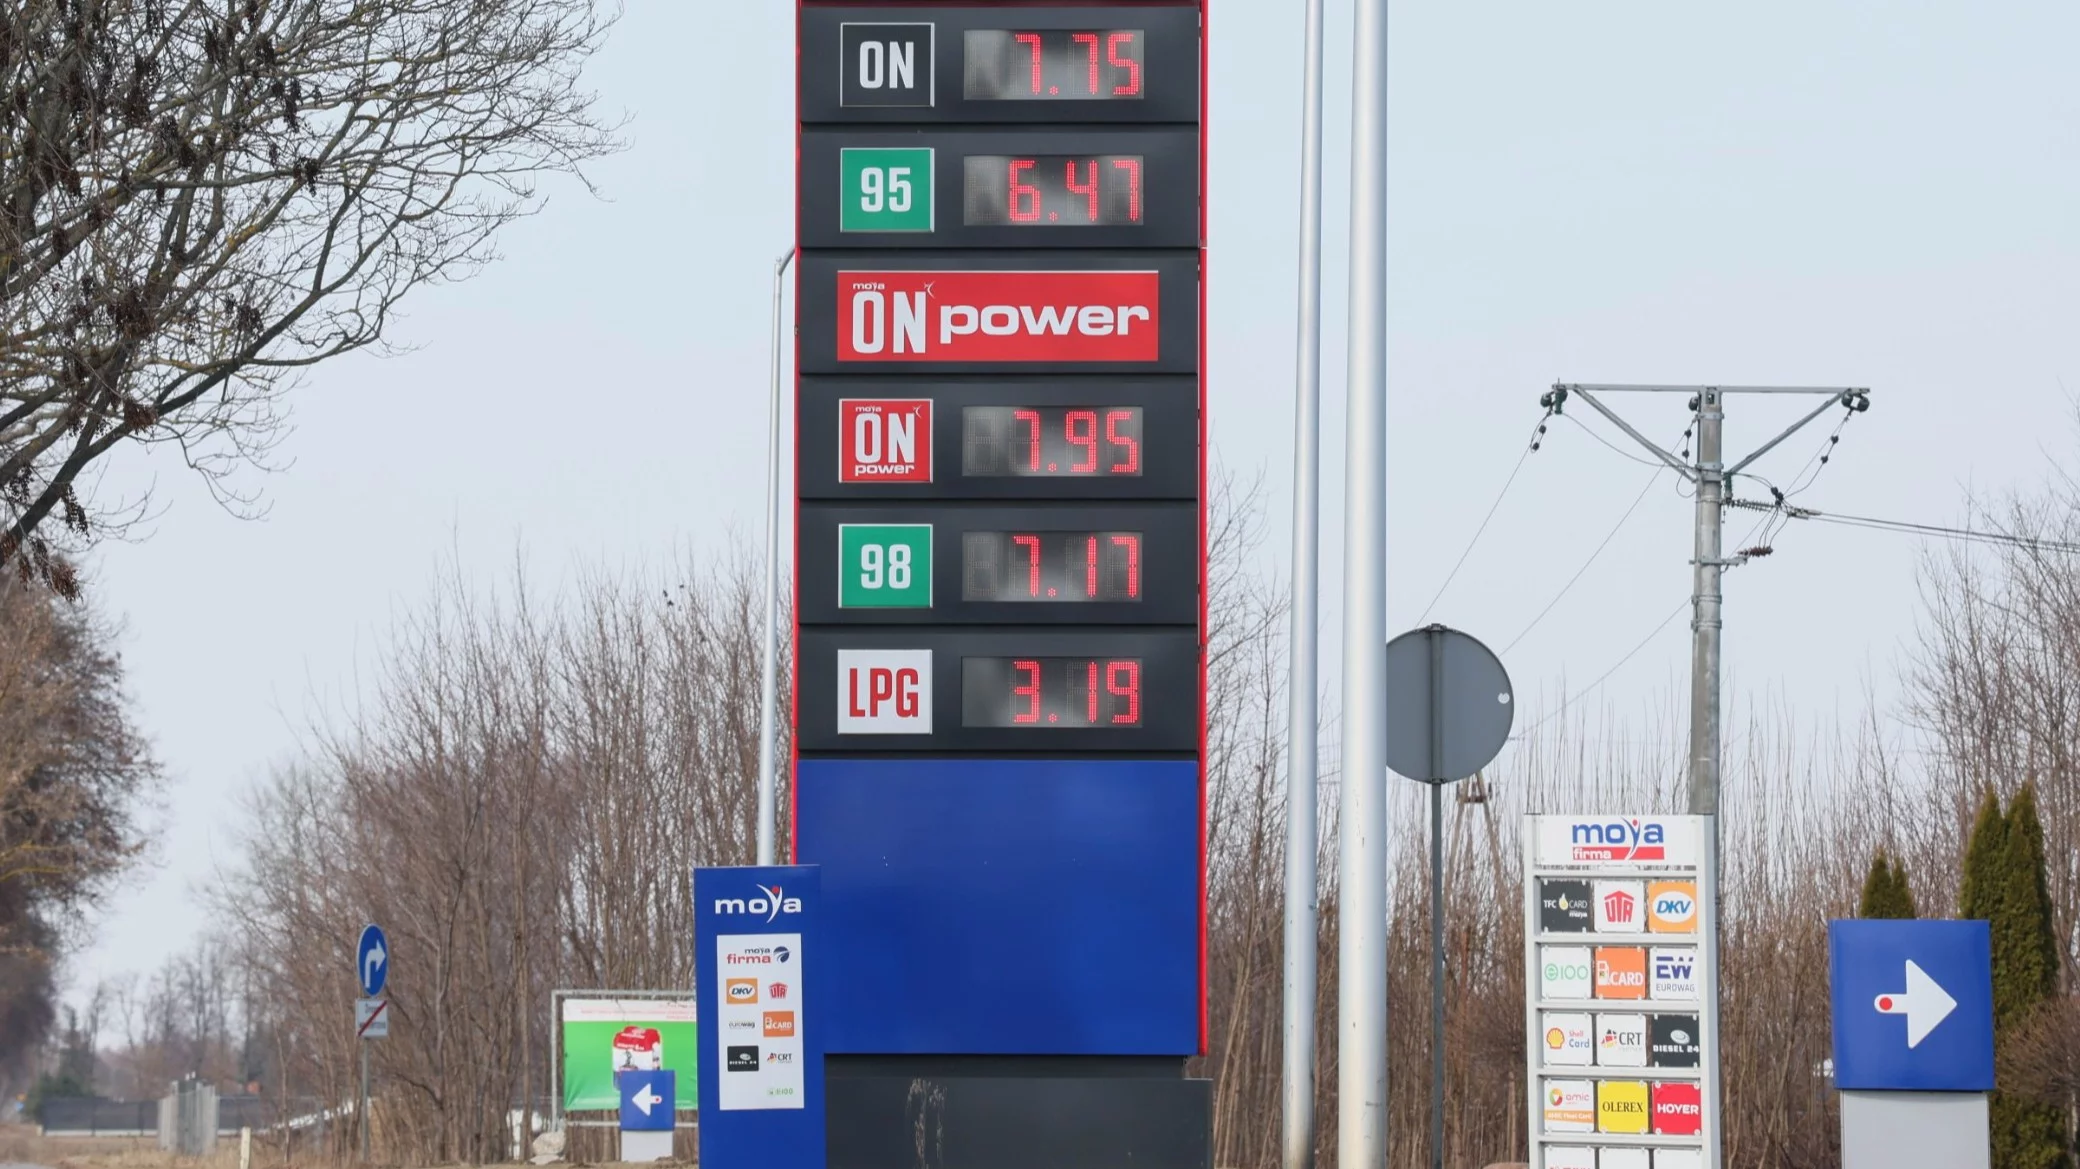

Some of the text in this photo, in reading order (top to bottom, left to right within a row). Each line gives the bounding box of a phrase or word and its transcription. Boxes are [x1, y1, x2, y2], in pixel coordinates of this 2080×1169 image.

[859, 41, 914, 89] ON
[1014, 33, 1140, 95] 7.75
[860, 167, 912, 212] 95
[1008, 160, 1139, 222] 6.47
[852, 291, 1149, 354] ON power
[855, 412, 915, 463] ON
[1014, 410, 1138, 473] 7.95
[855, 464, 915, 477] power
[860, 544, 912, 589] 98
[1013, 536, 1137, 598] 7.17
[849, 668, 919, 718] LPG
[1013, 661, 1138, 724] 3.19
[1572, 816, 1664, 858] moya
[1573, 847, 1612, 860] firma
[714, 884, 802, 923] moya
[1543, 900, 1588, 909] TFC CARD
[1604, 890, 1635, 923] UTA
[1656, 900, 1691, 914] DKV
[727, 953, 771, 964] firma
[731, 987, 753, 995] DKV
[769, 982, 788, 999] UTA
[1656, 983, 1695, 992] EUROWAG
[1568, 1039, 1590, 1048] Card
[1619, 1032, 1642, 1046] CRT
[777, 1053, 793, 1061] CRT
[1653, 1045, 1700, 1053] DIESEL 24
[1566, 1092, 1590, 1102] amic
[1602, 1101, 1644, 1113] OLEREX
[1657, 1103, 1699, 1115] HOYER
